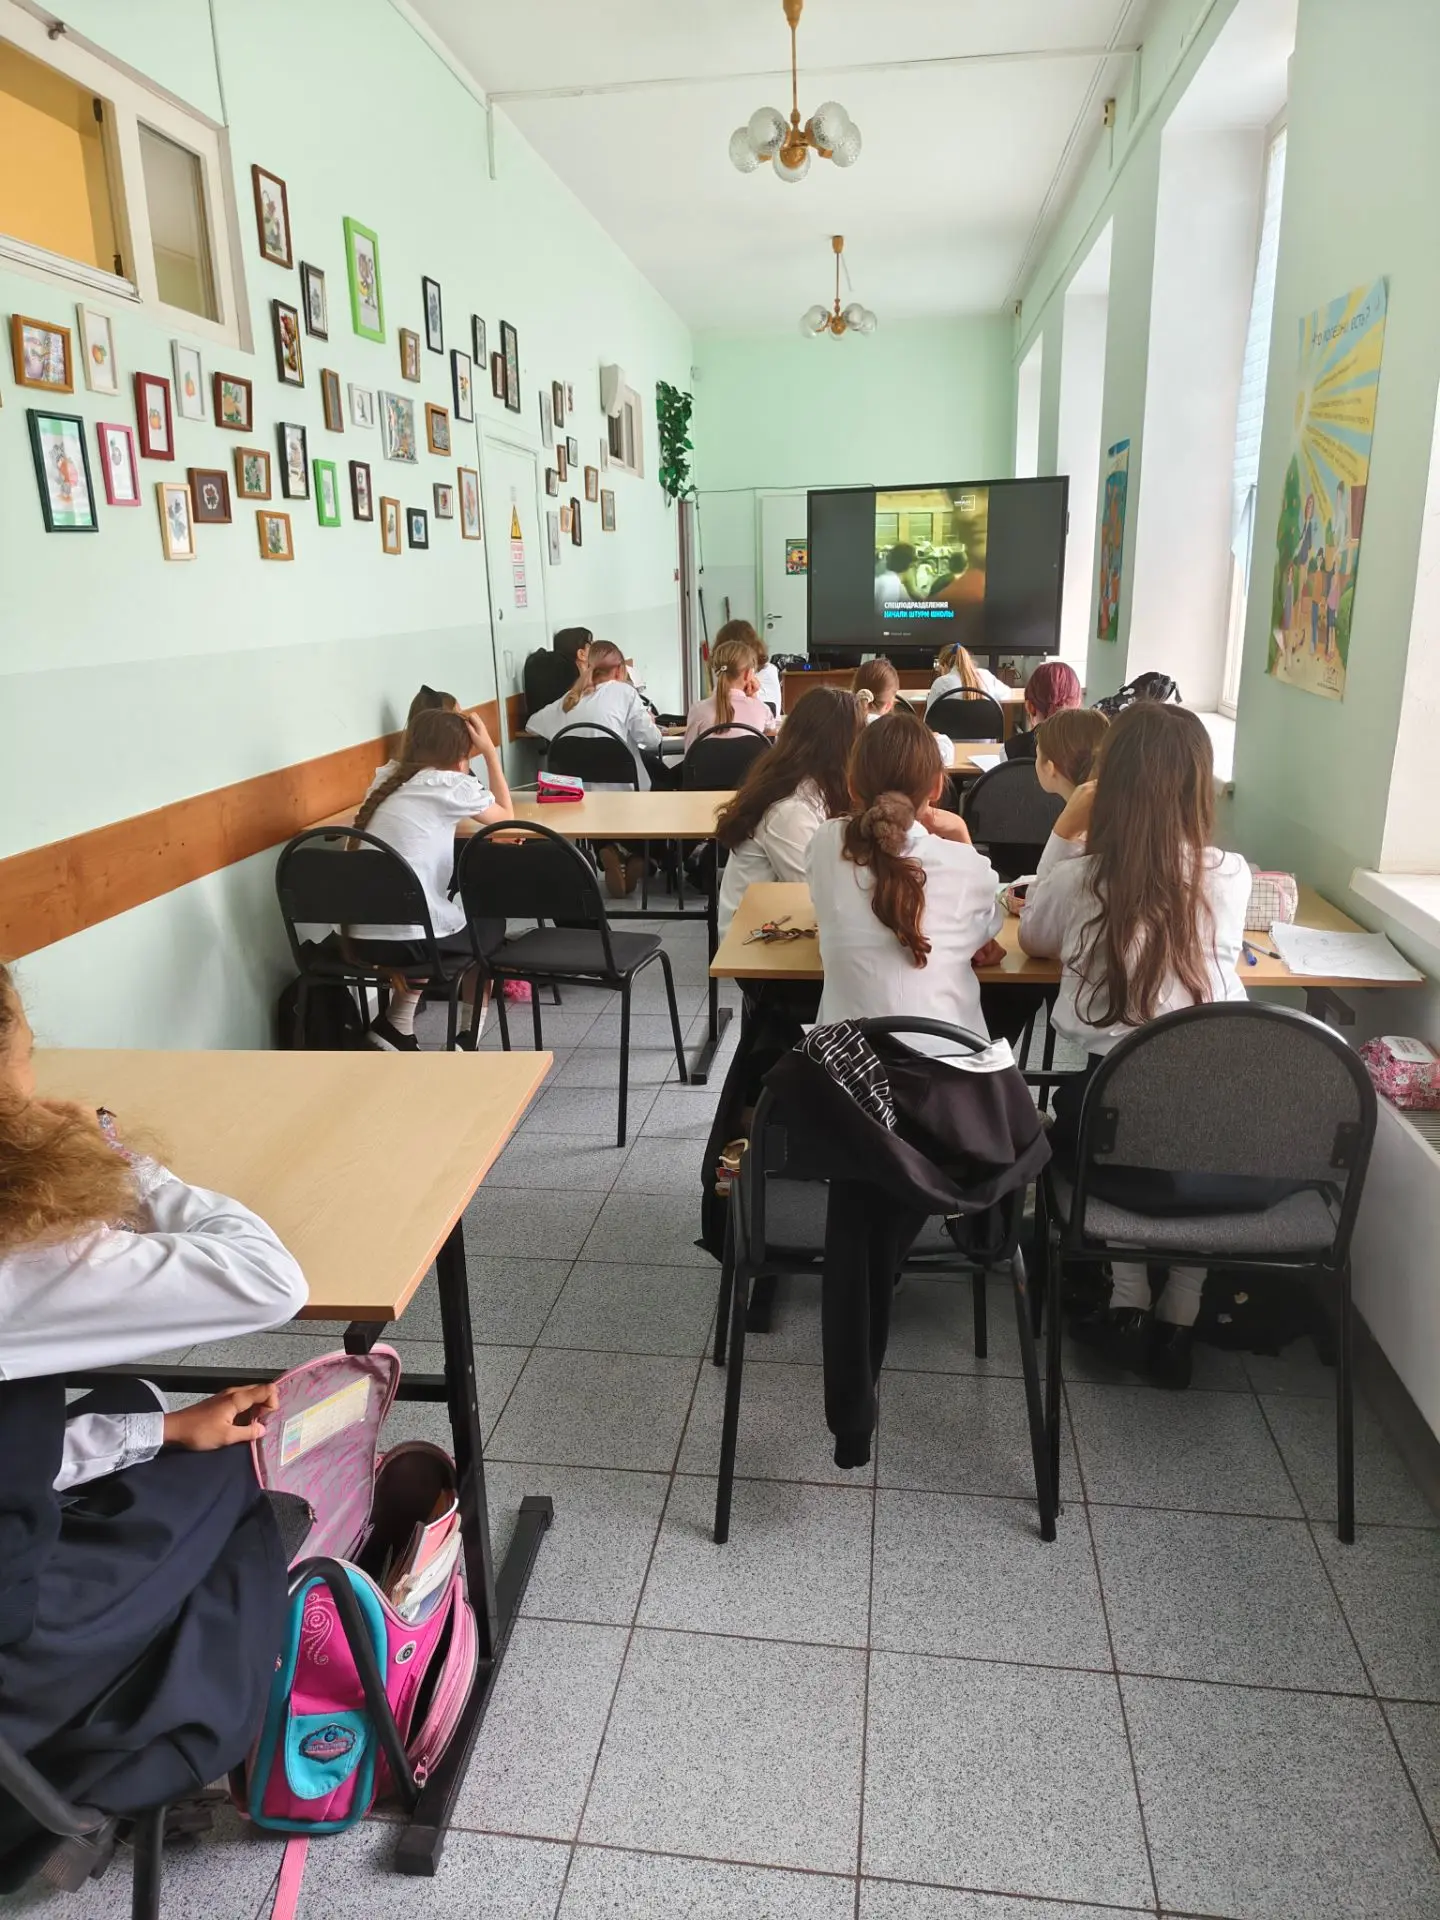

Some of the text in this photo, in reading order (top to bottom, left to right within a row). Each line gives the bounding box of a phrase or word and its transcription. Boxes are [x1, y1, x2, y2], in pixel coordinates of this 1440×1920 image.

[884, 601, 948, 609] СПЕЦПОДРАЗДЕЛЕНИЯ
[884, 610, 954, 618] НАЧАЛИ ШТУРМ ШКОЛЫ
